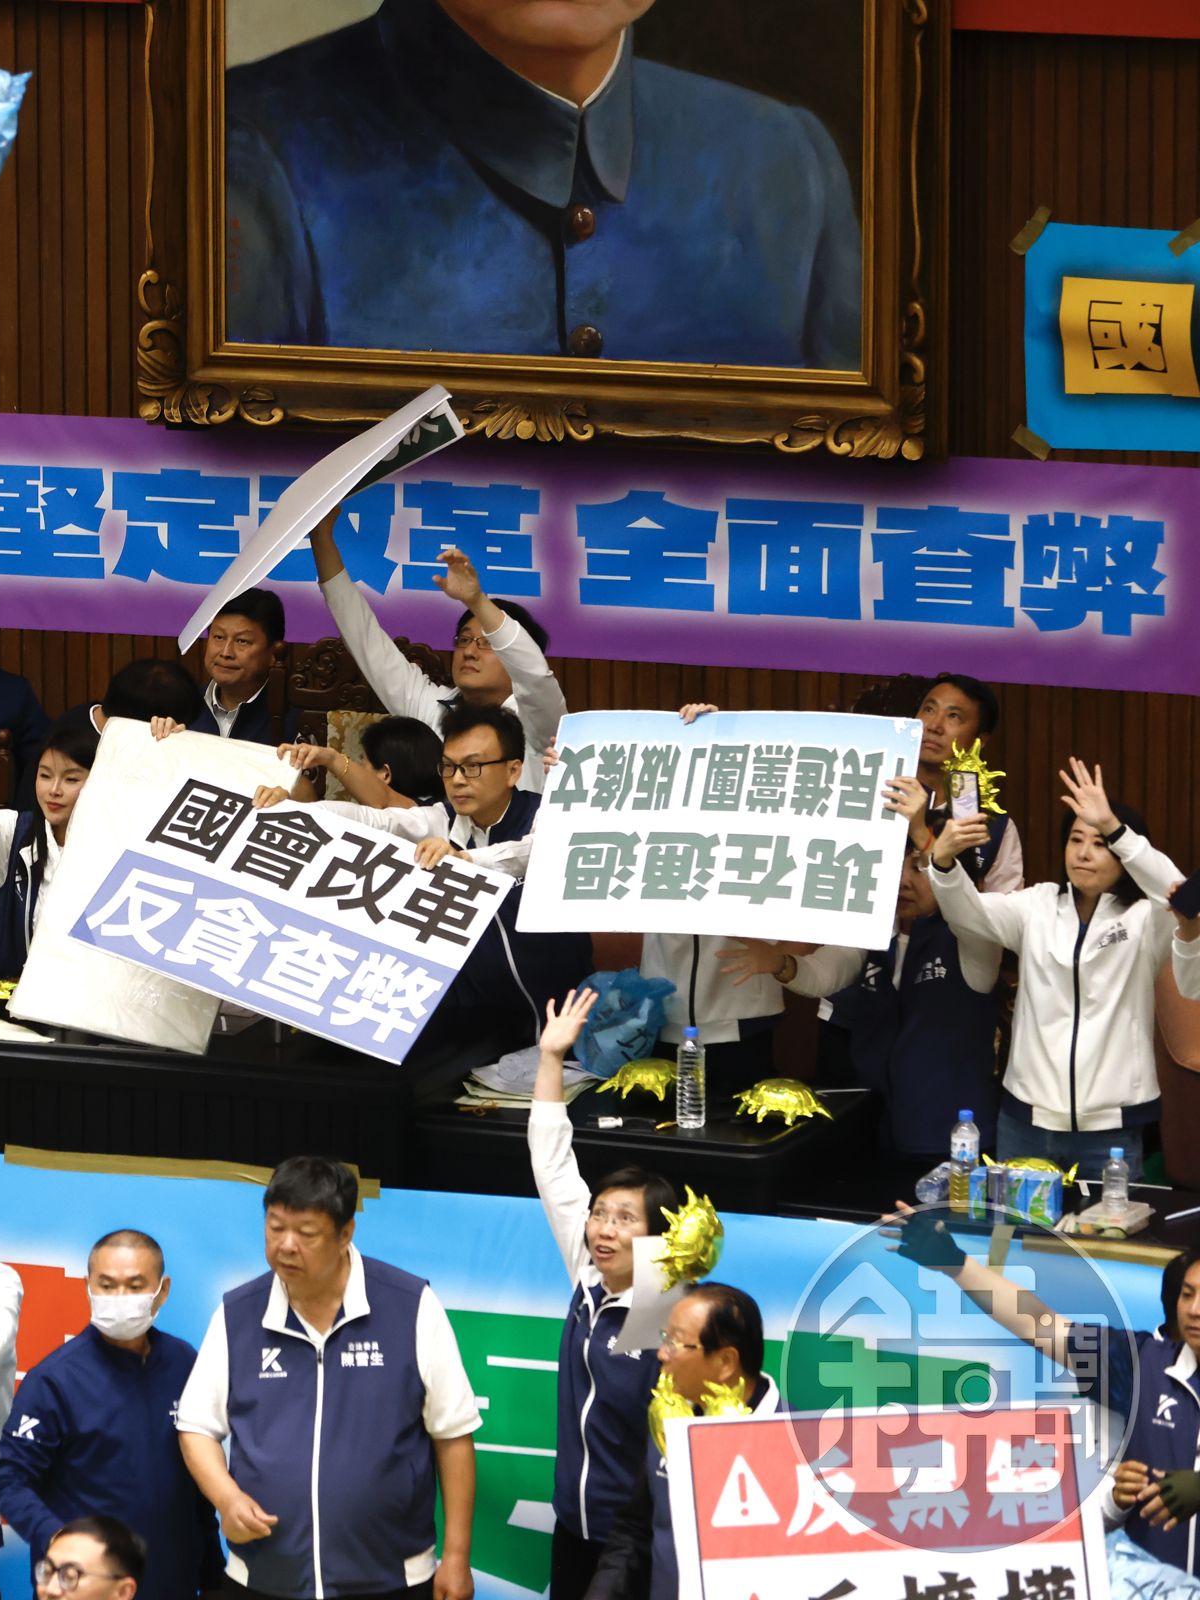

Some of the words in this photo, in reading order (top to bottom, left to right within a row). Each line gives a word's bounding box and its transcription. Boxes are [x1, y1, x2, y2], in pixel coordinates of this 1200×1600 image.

[1088, 299, 1168, 373] 國
[575, 490, 1168, 637] 全面查弊
[146, 778, 499, 946] 國會改革
[562, 831, 883, 914] 現在通過
[87, 868, 443, 1044] 反貪查弊
[786, 1436, 1065, 1537] 反黑箱
